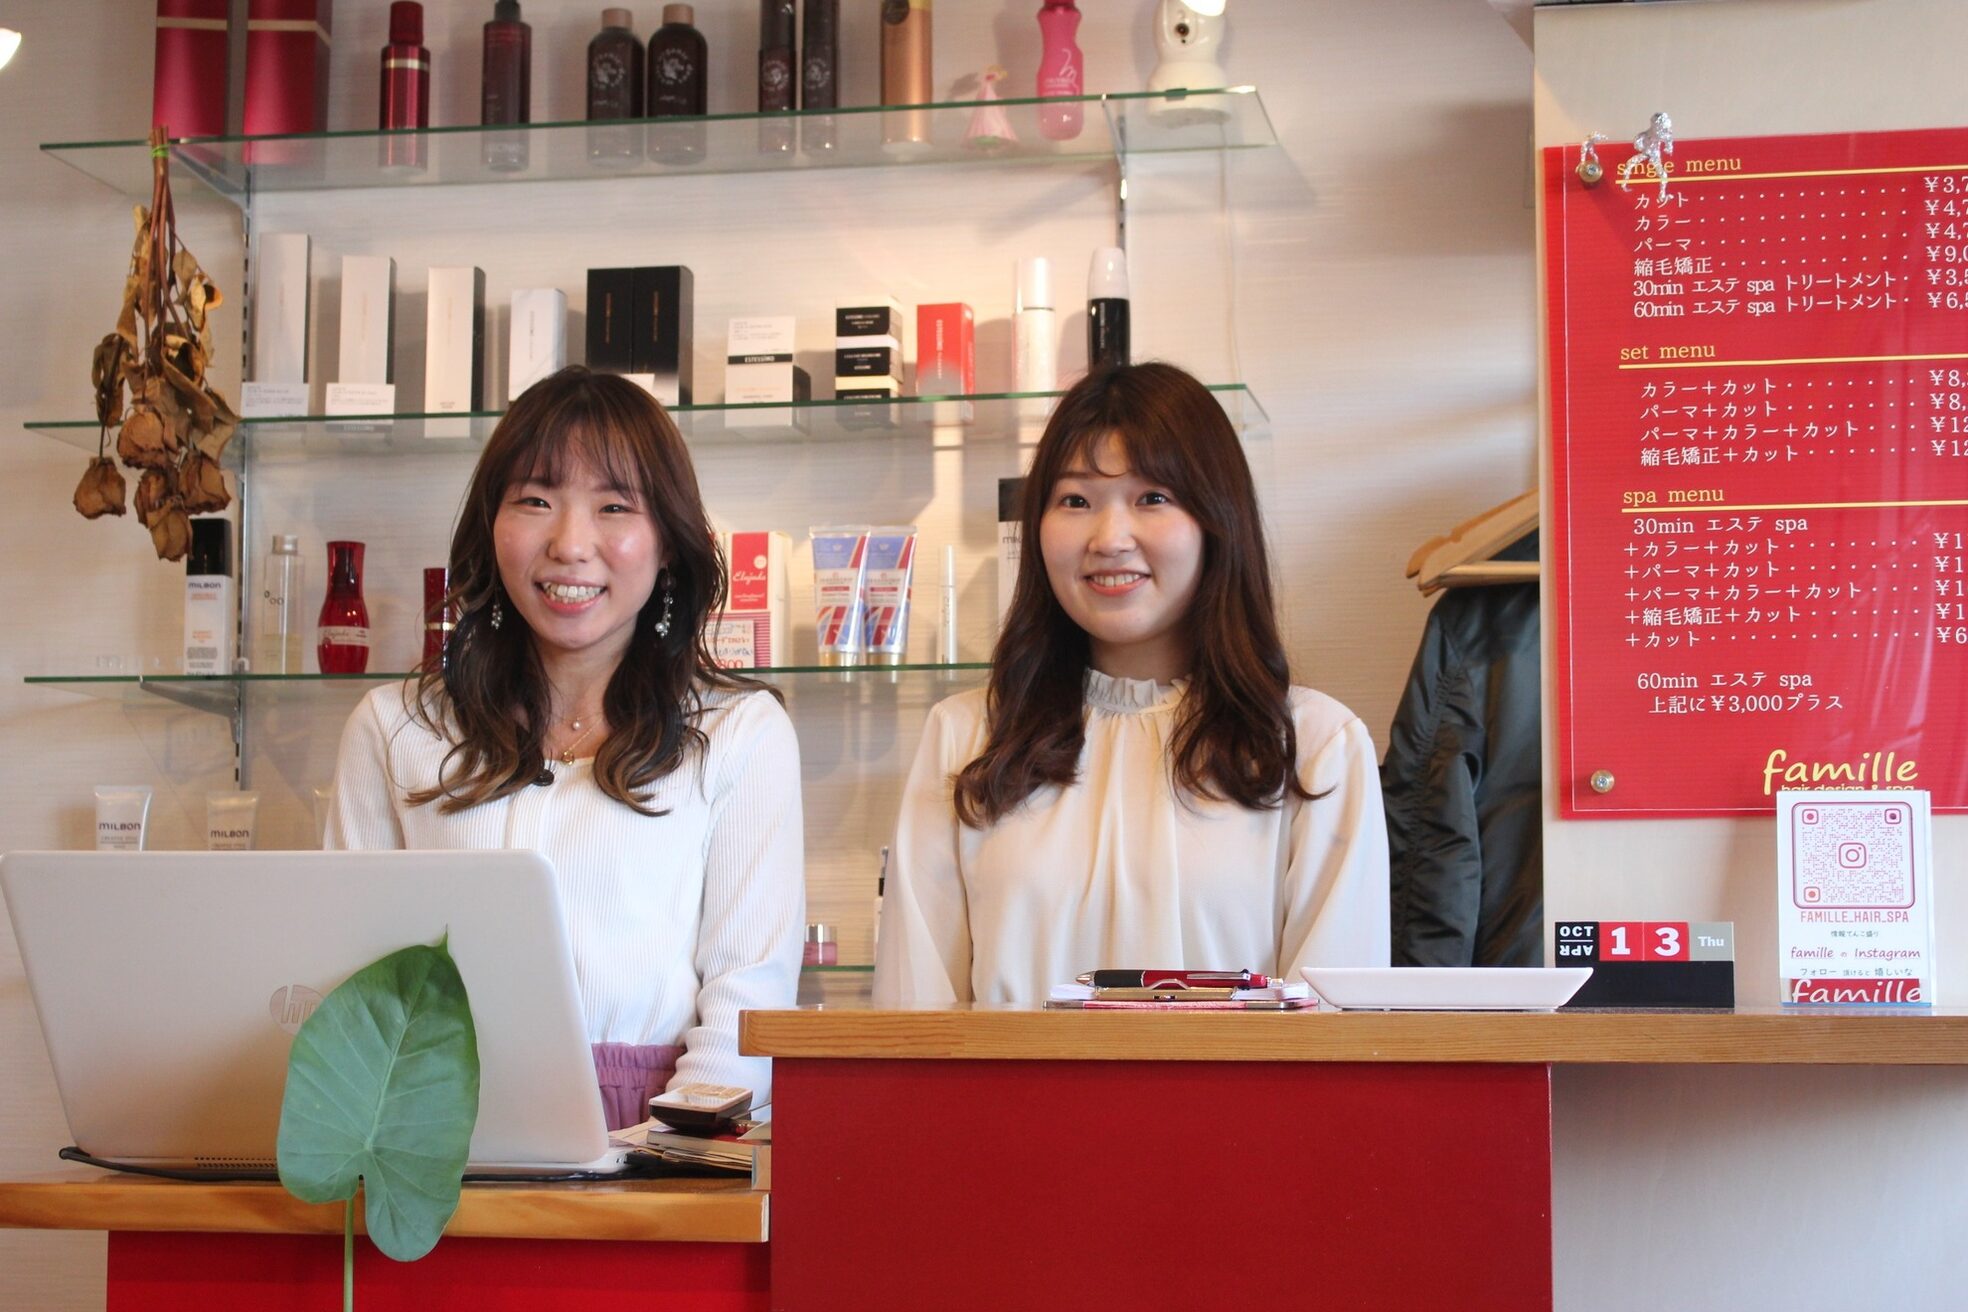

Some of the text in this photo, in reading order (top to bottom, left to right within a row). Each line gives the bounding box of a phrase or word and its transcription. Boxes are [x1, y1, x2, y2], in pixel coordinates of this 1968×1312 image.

[1616, 156, 1742, 178] snge menu
[1634, 191, 1689, 210] カット
[1634, 214, 1691, 232] カラー
[1634, 237, 1691, 252] パーマ
[1633, 256, 1713, 276] 縮毛矯正
[1633, 279, 1684, 296] 30min
[1692, 278, 1740, 293] エステ
[1747, 280, 1775, 295] spa
[1786, 272, 1897, 292] トリートメント
[1633, 300, 1685, 318] 60min
[1692, 299, 1740, 314] エステ
[1747, 301, 1775, 317] spa
[1786, 294, 1897, 312] トリートメント
[1620, 345, 1716, 361] set menu
[1623, 489, 1725, 508] spa menu
[1633, 517, 1808, 535] 30min エステ spa
[1637, 672, 1813, 690] 60min エステ spa
[1763, 749, 1919, 795] famille
[1799, 910, 1910, 923] FAMILLE_HAIR_SPA
[1559, 925, 1594, 938] OCT
[1559, 944, 1594, 957] APR
[1698, 936, 1724, 947] Thu
[1790, 946, 1834, 959] famille
[1854, 947, 1921, 962] Instagram
[1799, 967, 1837, 977] フォロー
[1792, 978, 1922, 1004] famille
